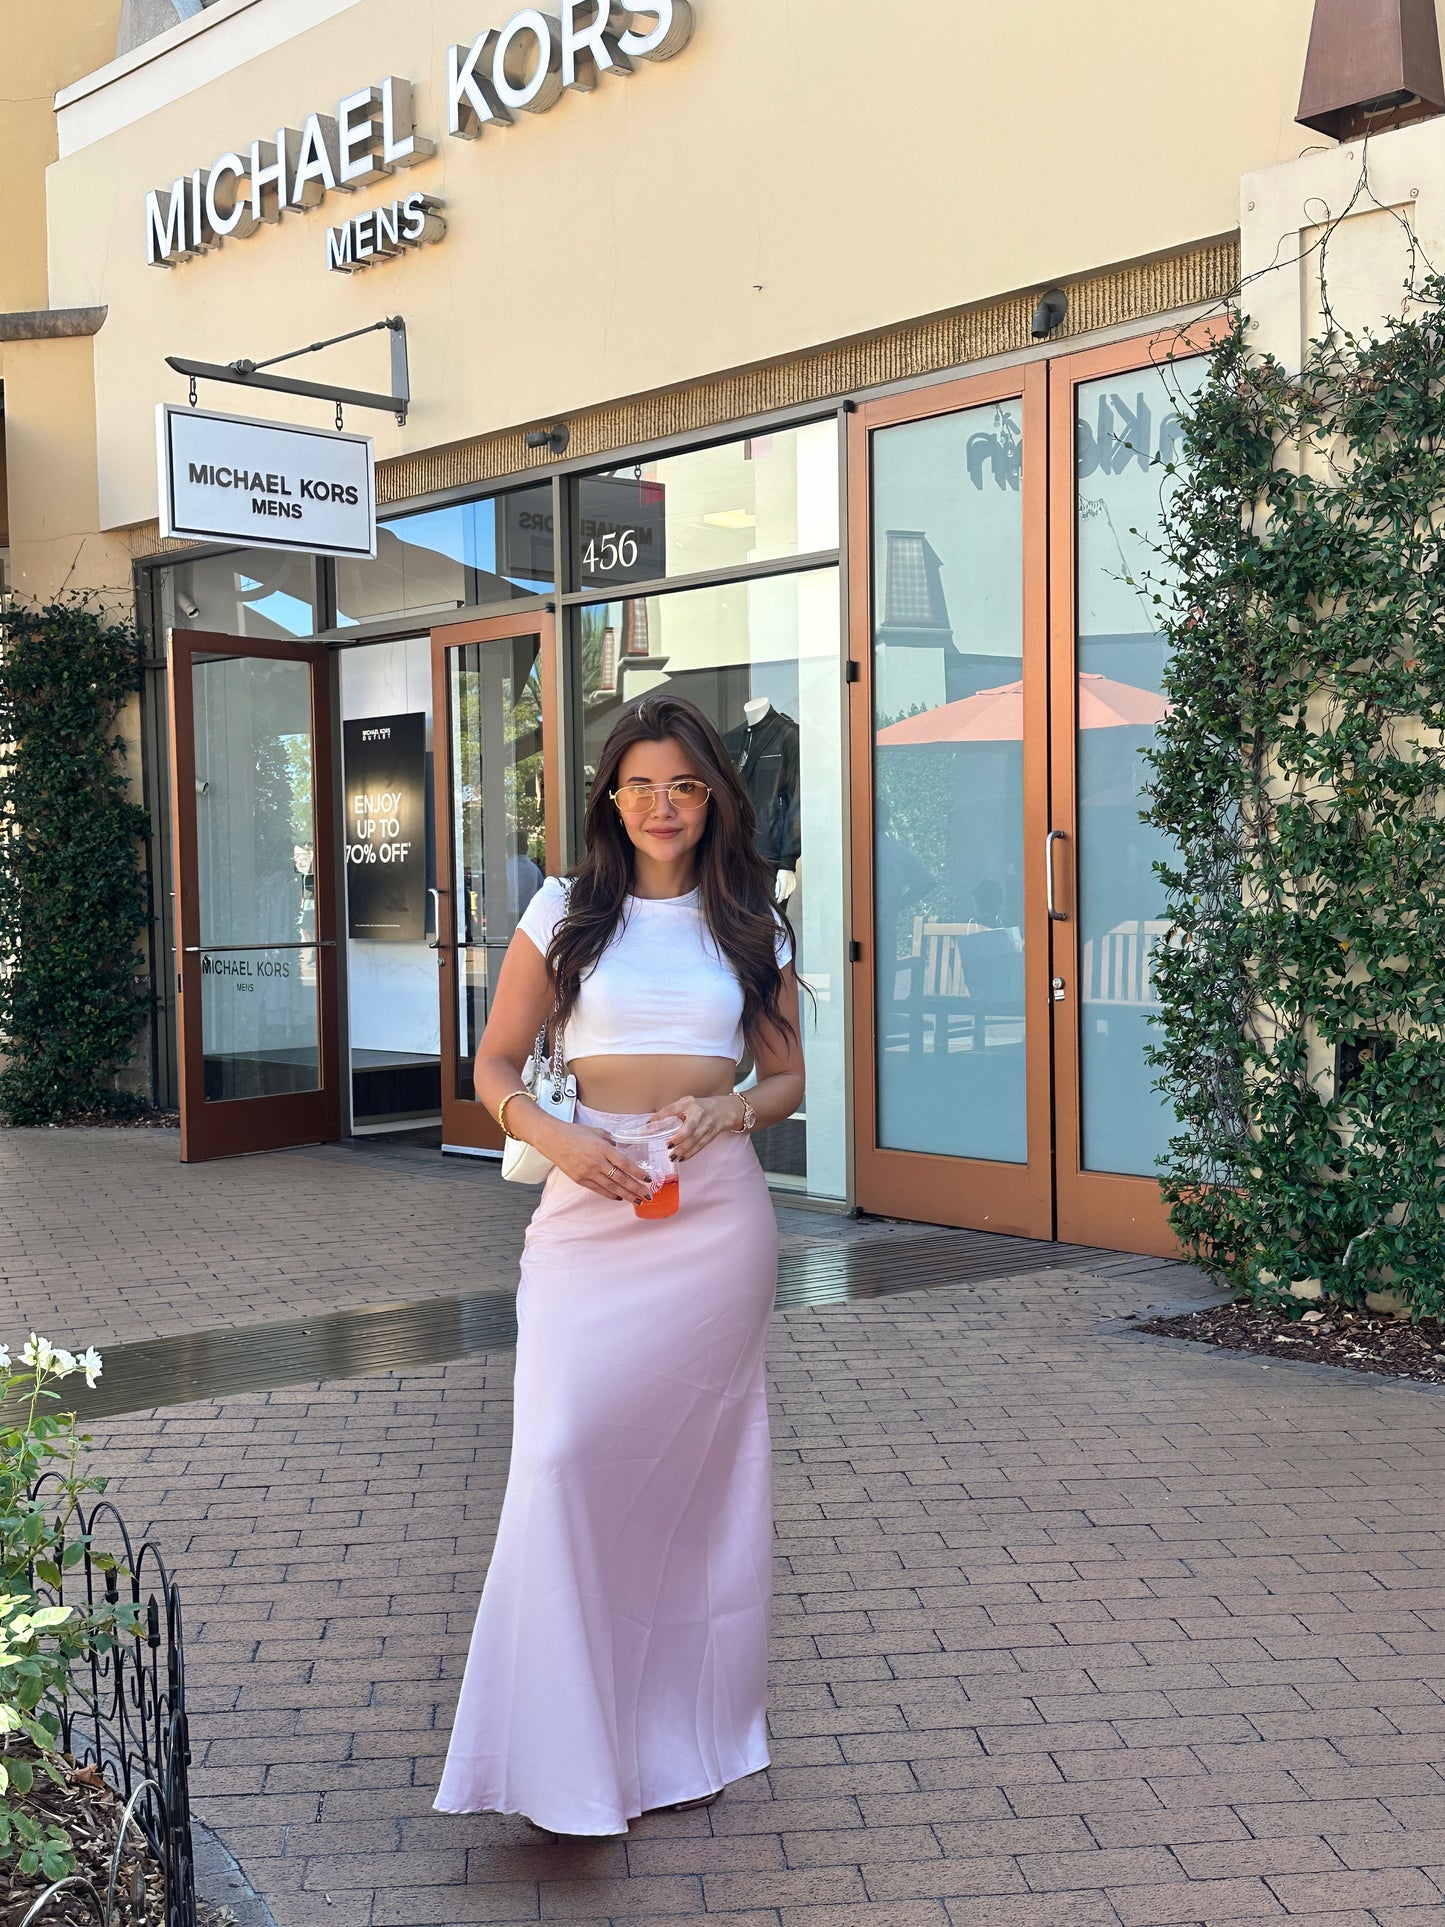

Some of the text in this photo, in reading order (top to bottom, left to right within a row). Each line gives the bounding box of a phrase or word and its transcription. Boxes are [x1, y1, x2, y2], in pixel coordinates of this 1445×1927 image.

[145, 0, 676, 266] MICHAEL KORS
[326, 192, 426, 271] MENS
[188, 462, 359, 506] MICHAEL KORS
[252, 498, 303, 519] MENS
[583, 529, 638, 573] 456
[354, 793, 402, 814] ENJOY
[356, 817, 400, 839] UP TO
[346, 843, 377, 864] 70%
[202, 958, 290, 978] MICHAEL KORS
